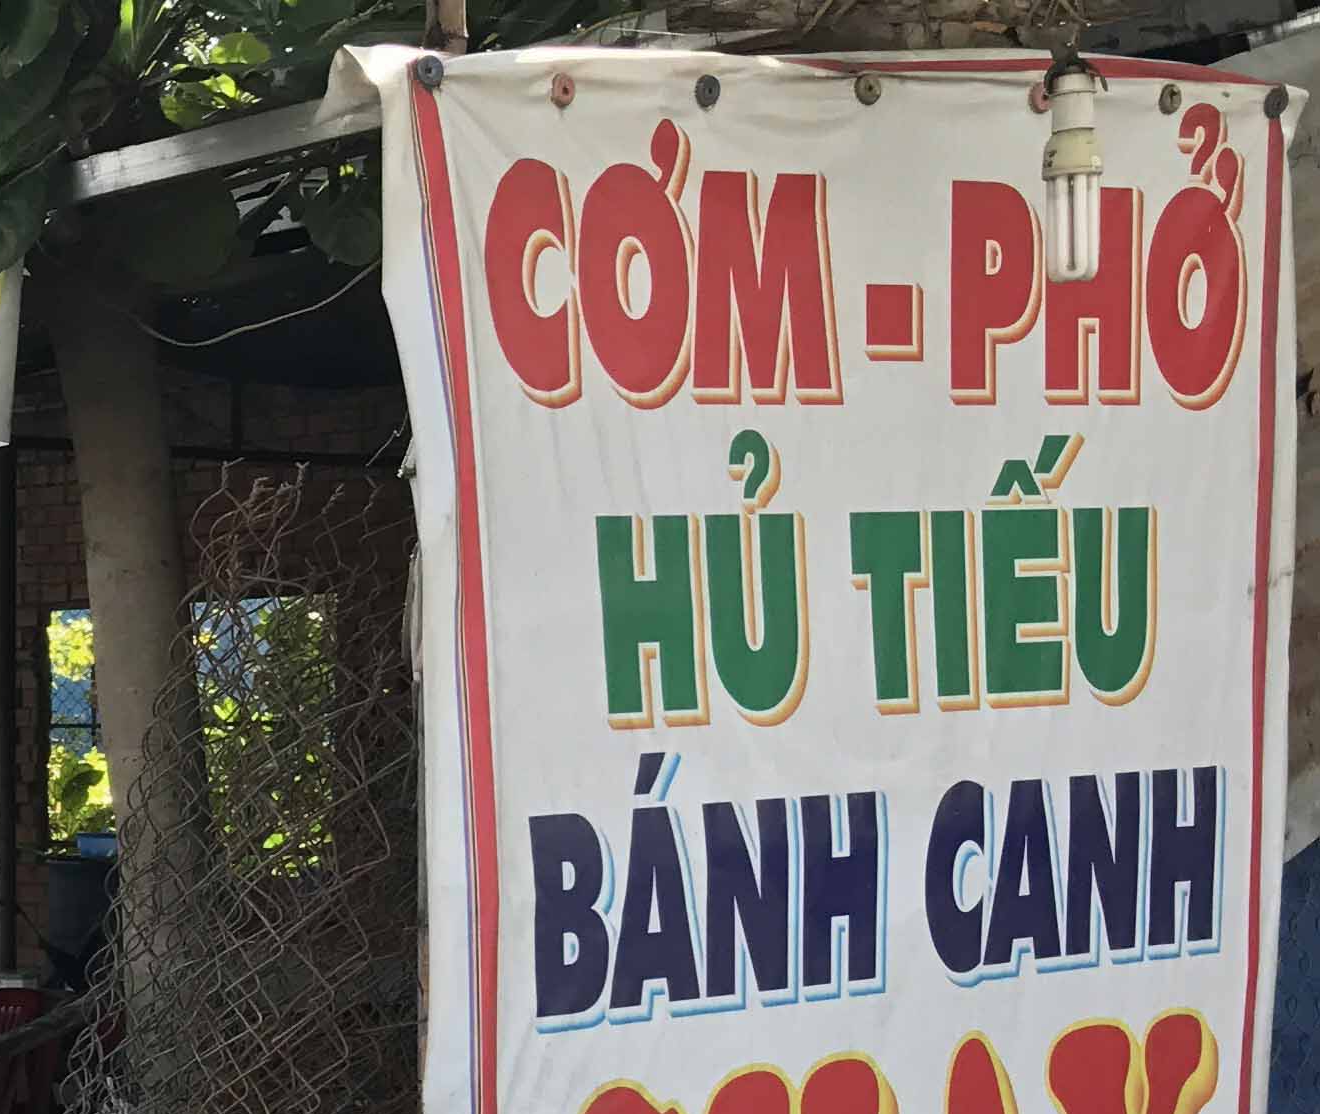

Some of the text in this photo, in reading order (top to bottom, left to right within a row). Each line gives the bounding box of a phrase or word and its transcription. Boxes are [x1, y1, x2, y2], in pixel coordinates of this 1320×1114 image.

[484, 118, 843, 410] CƠM
[949, 102, 1247, 411] PHỞ
[595, 429, 1162, 730] HỦ TIẾU
[528, 752, 1227, 1033] BÁNH CANH
